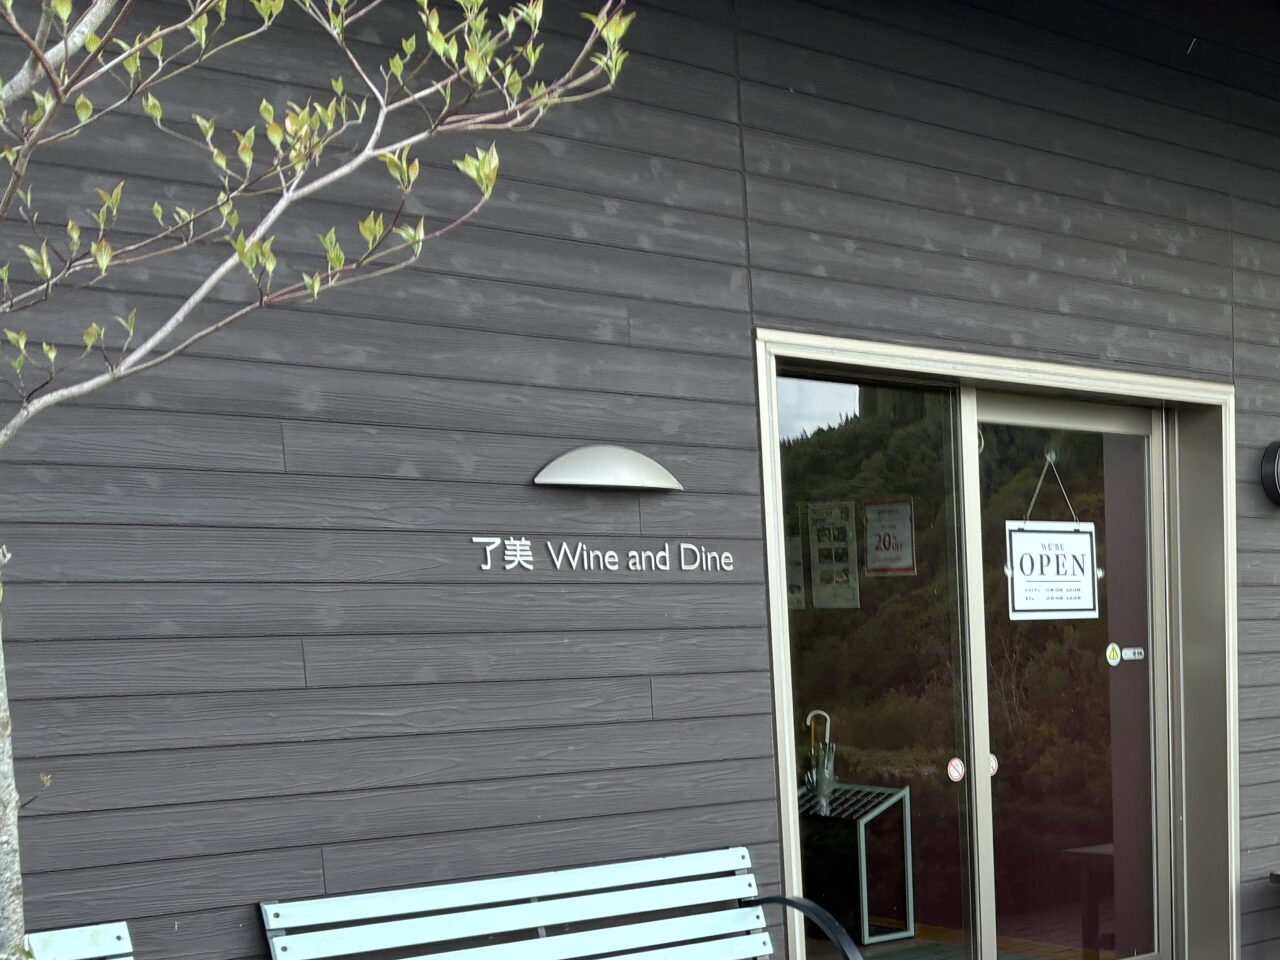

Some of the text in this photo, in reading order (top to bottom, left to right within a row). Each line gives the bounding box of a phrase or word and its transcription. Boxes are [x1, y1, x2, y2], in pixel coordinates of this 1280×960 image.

[472, 536, 734, 572] 了美 Wine and Dine
[1019, 552, 1087, 577] OPEN
